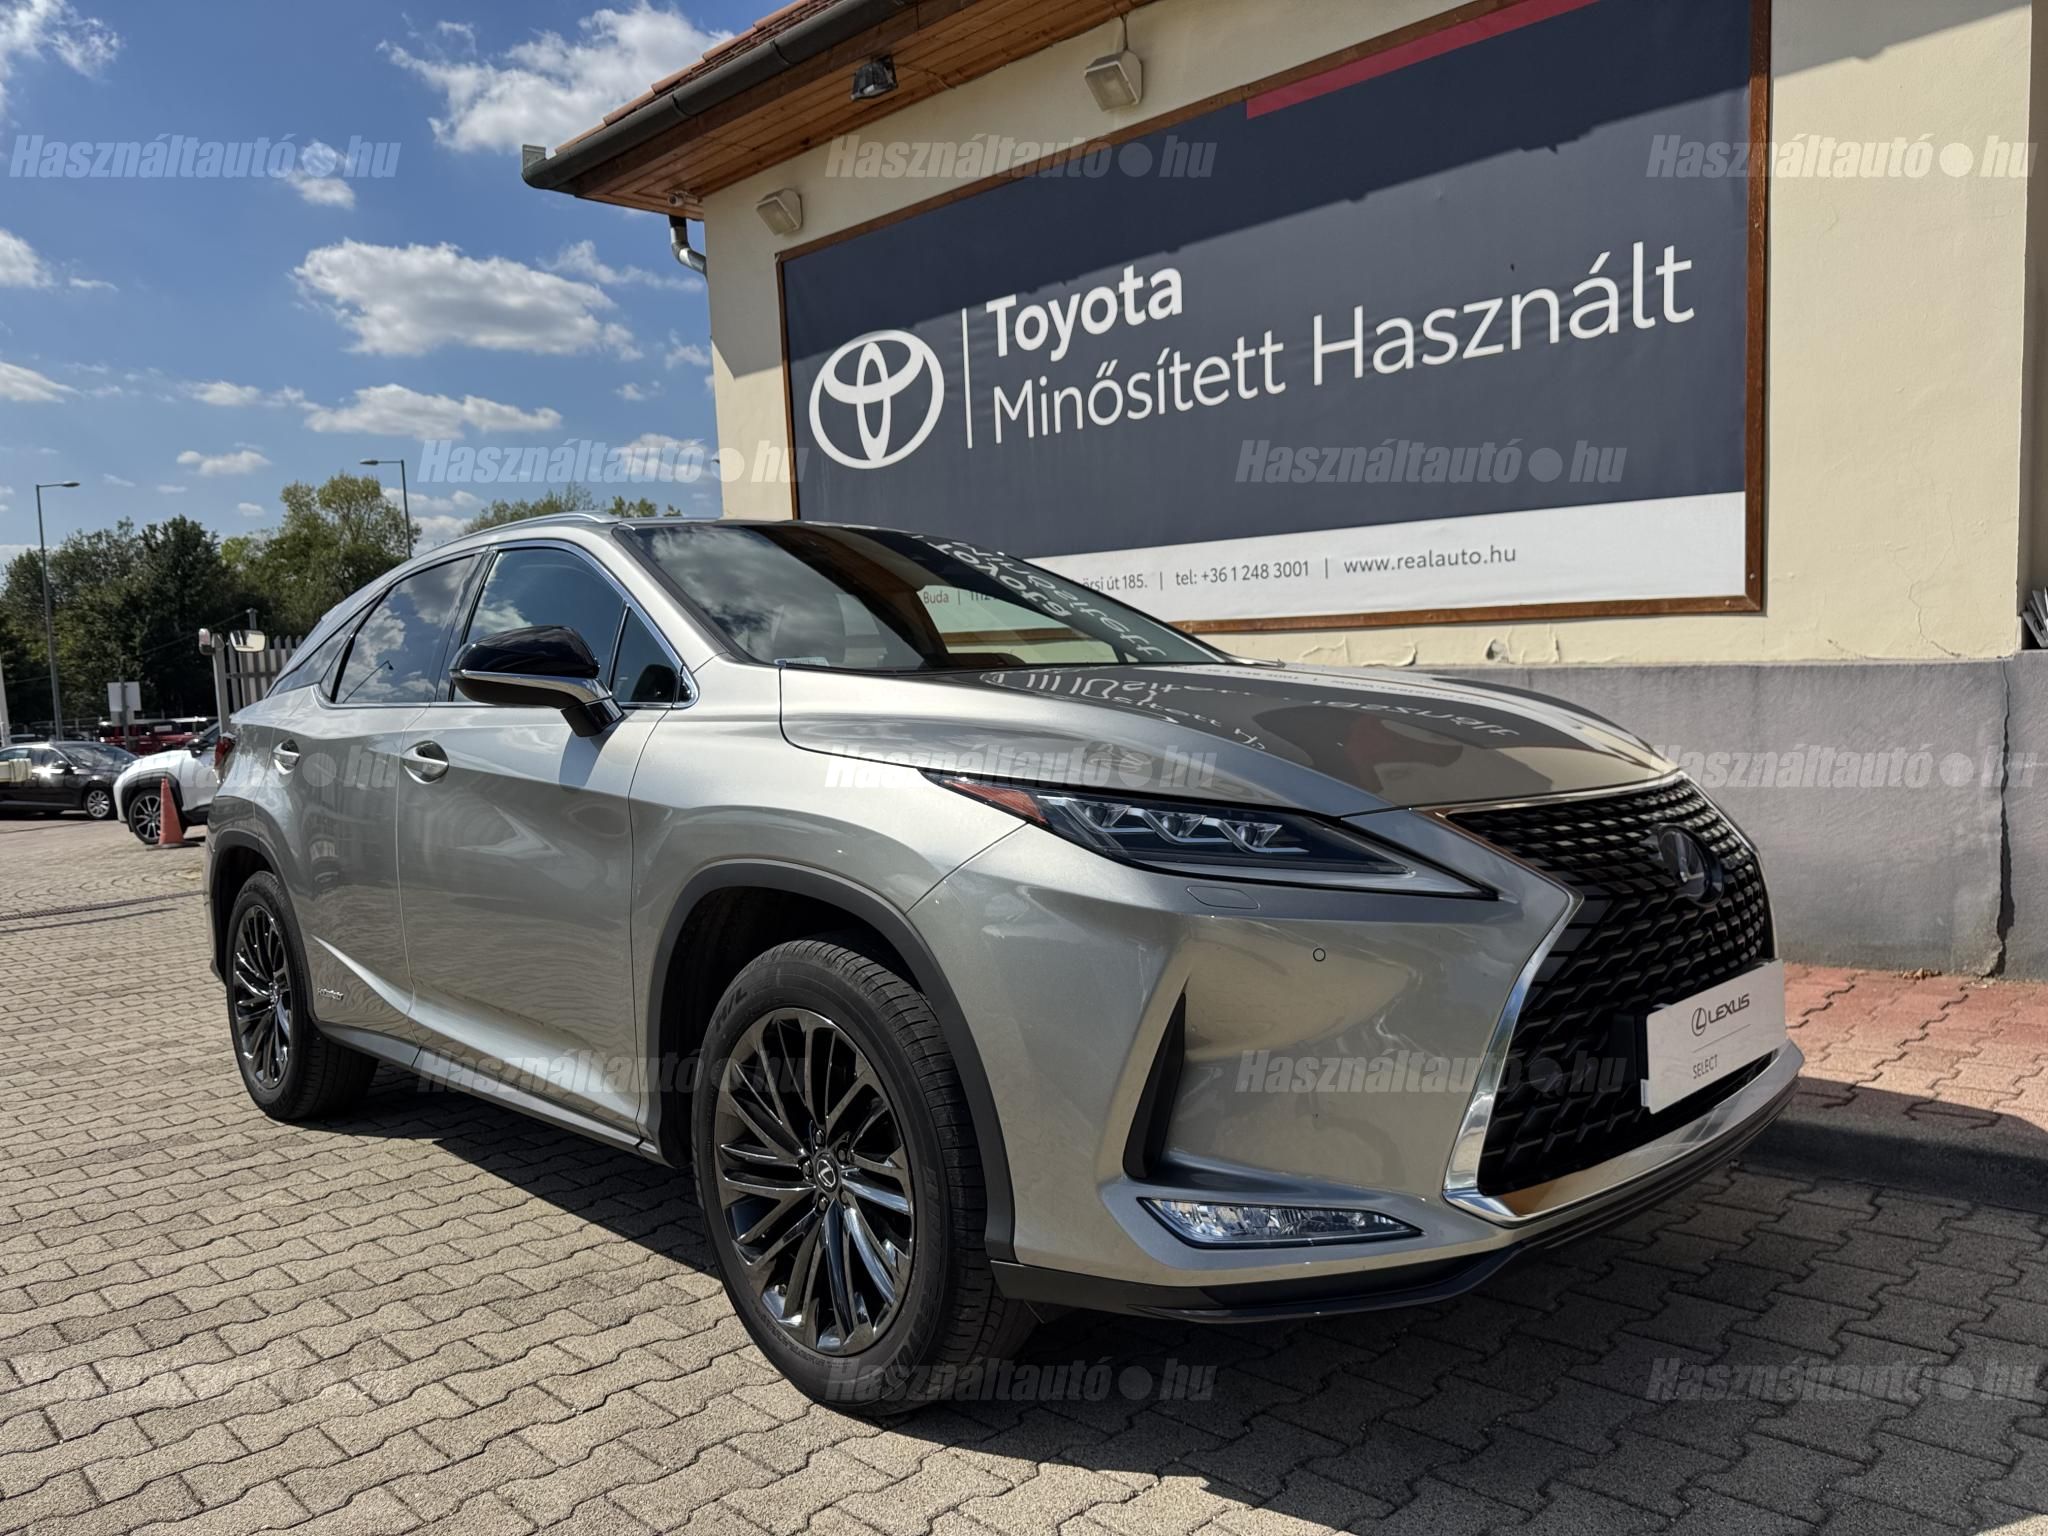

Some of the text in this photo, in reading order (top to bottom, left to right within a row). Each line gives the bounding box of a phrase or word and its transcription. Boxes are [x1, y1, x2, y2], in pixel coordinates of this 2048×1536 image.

[986, 265, 1183, 361] Toyota
[993, 241, 1695, 444] Minősített Használt
[923, 591, 949, 604] Buda
[1106, 575, 1120, 591] út
[1122, 574, 1148, 590] 185.
[1175, 568, 1198, 586] tel:
[1201, 567, 1228, 584] +36
[1241, 563, 1270, 582] 248
[1273, 560, 1310, 578] 3001
[1343, 544, 1516, 574] www.realauto.hu
[1708, 993, 1751, 1024] LEXUS
[1692, 1053, 1719, 1080] SELECT
